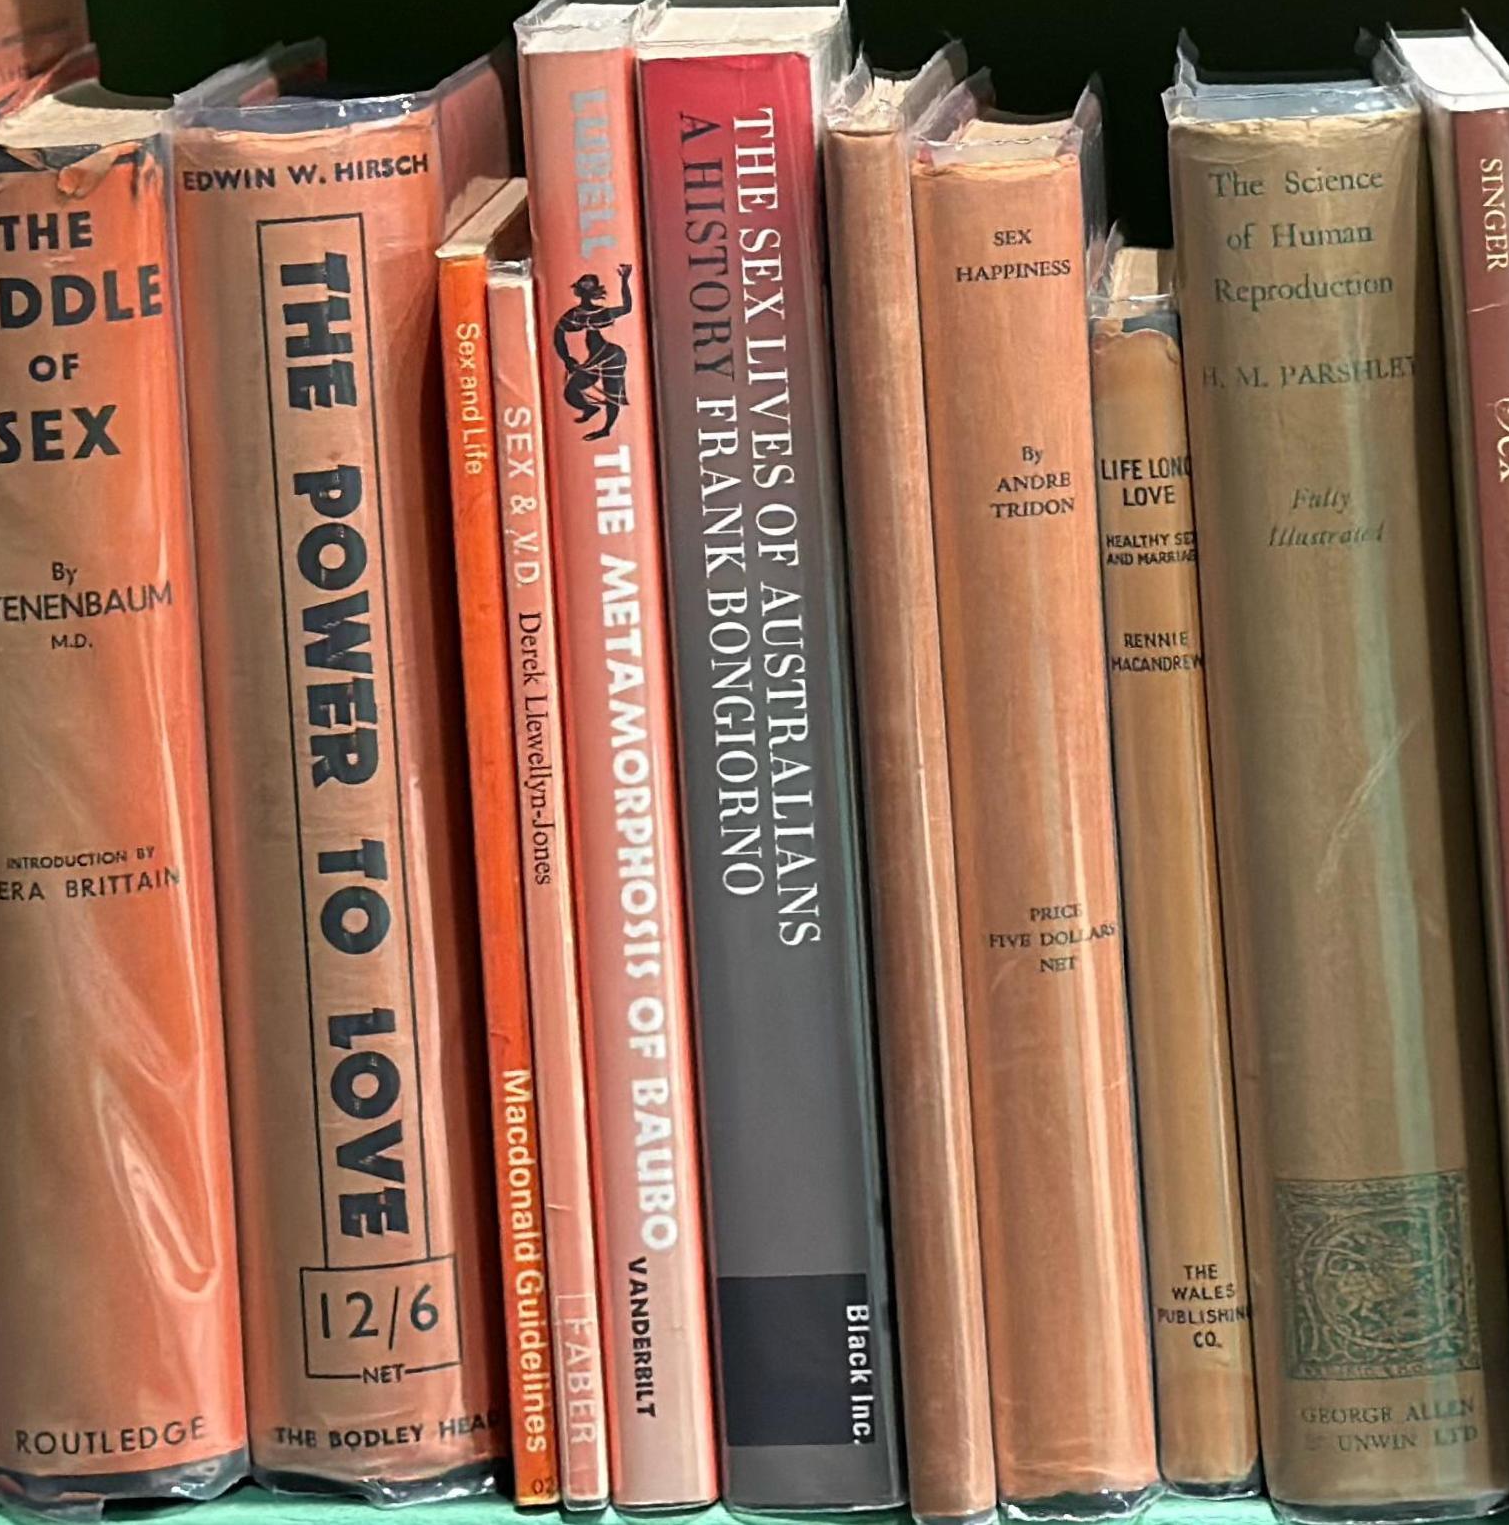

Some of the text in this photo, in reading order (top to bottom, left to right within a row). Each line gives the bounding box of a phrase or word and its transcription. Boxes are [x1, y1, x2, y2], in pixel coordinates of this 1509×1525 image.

[183, 153, 430, 192] EDWIN W. HIRSCH
[1209, 166, 1385, 198] The Science
[1480, 158, 1509, 272] SINGER
[993, 228, 1032, 247] SEX
[1226, 222, 1375, 250] of Human
[682, 156, 737, 382] HISTORY
[955, 258, 1072, 284] HAPPINESS
[1214, 270, 1395, 313] Reproduction
[28, 352, 80, 382] OF
[456, 322, 490, 475] Sex and Life
[503, 405, 535, 477] SEX
[1022, 445, 1044, 465] By
[996, 471, 1072, 494] ANDRE
[1101, 459, 1143, 481] LIFE
[990, 496, 1076, 520] TRIDON
[1123, 484, 1177, 507] LOVE
[732, 107, 822, 949] THE SEX LIVES OF AUSTRALIANS
[1105, 533, 1169, 549] HEALTHY
[51, 562, 78, 586] By
[518, 611, 543, 686] Derek
[695, 393, 767, 898] FRANK BONGIORNO
[1123, 630, 1189, 649] RENNIE
[280, 251, 410, 1239] THE POWER TO LOVE
[7, 846, 155, 871] INTRODUCTION BY
[593, 444, 678, 1252] THE METAMORPHOSIS BAUBO
[1030, 903, 1083, 923] PRICE
[990, 932, 1032, 949] FIVE
[1040, 956, 1078, 973] NET
[503, 1069, 547, 1454] Macdonald Guidelines
[1184, 1263, 1219, 1281] THE
[1172, 1282, 1236, 1301] WALES
[627, 1256, 656, 1418] VANDERBILT
[362, 1363, 406, 1385] NET
[844, 1303, 876, 1447] Black Inc.
[1299, 1405, 1394, 1425] GEORGE
[15, 1416, 206, 1457] ROUTLEDGE
[275, 1423, 424, 1450] THE BODLEY
[1338, 1431, 1419, 1452] UNWIN
